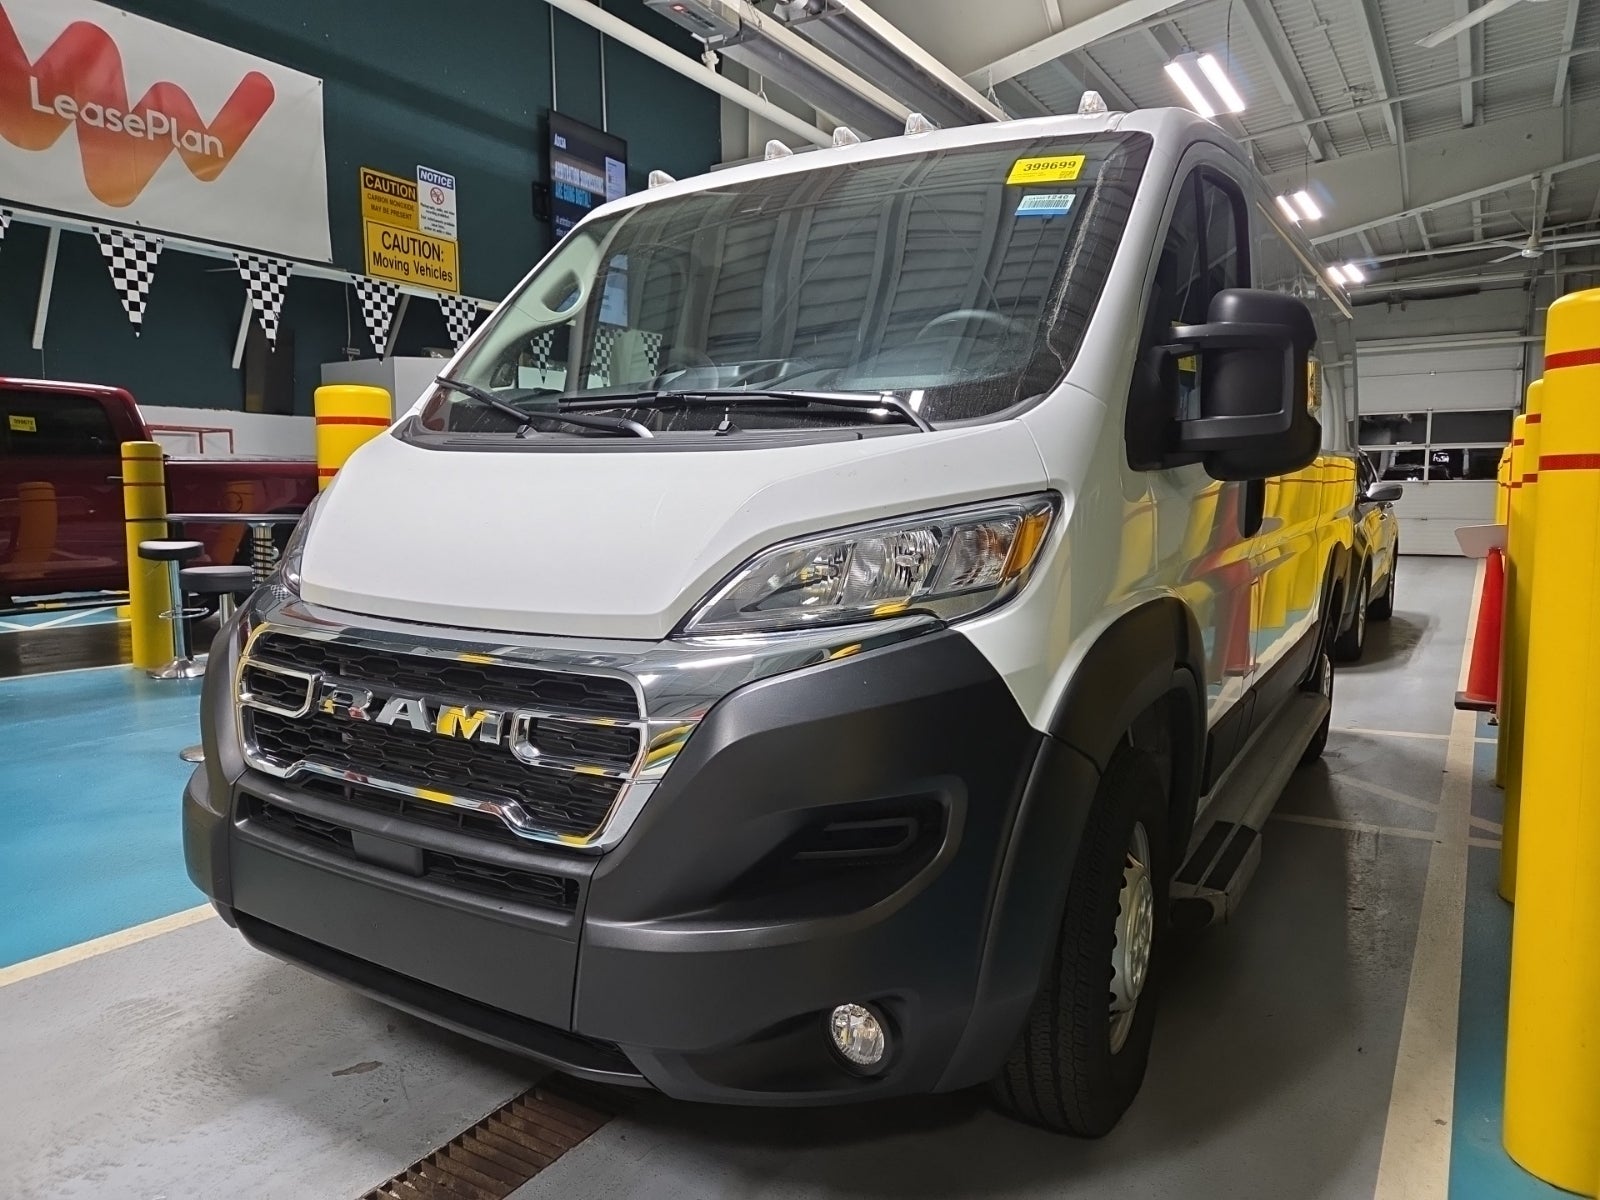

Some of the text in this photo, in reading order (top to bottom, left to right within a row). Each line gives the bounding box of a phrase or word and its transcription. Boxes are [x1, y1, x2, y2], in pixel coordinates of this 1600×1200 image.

[30, 76, 224, 158] LeasePlan
[420, 170, 452, 188] NOTICE
[1023, 160, 1076, 172] 399699
[365, 174, 416, 200] CAUTION
[367, 193, 389, 203] CARBON
[371, 204, 382, 212] MAY
[382, 206, 390, 214] BE
[390, 208, 412, 220] PRESENT
[381, 230, 444, 263] CAUTION:
[373, 251, 453, 282] Moving Vehicles
[319, 681, 504, 746] RAM
